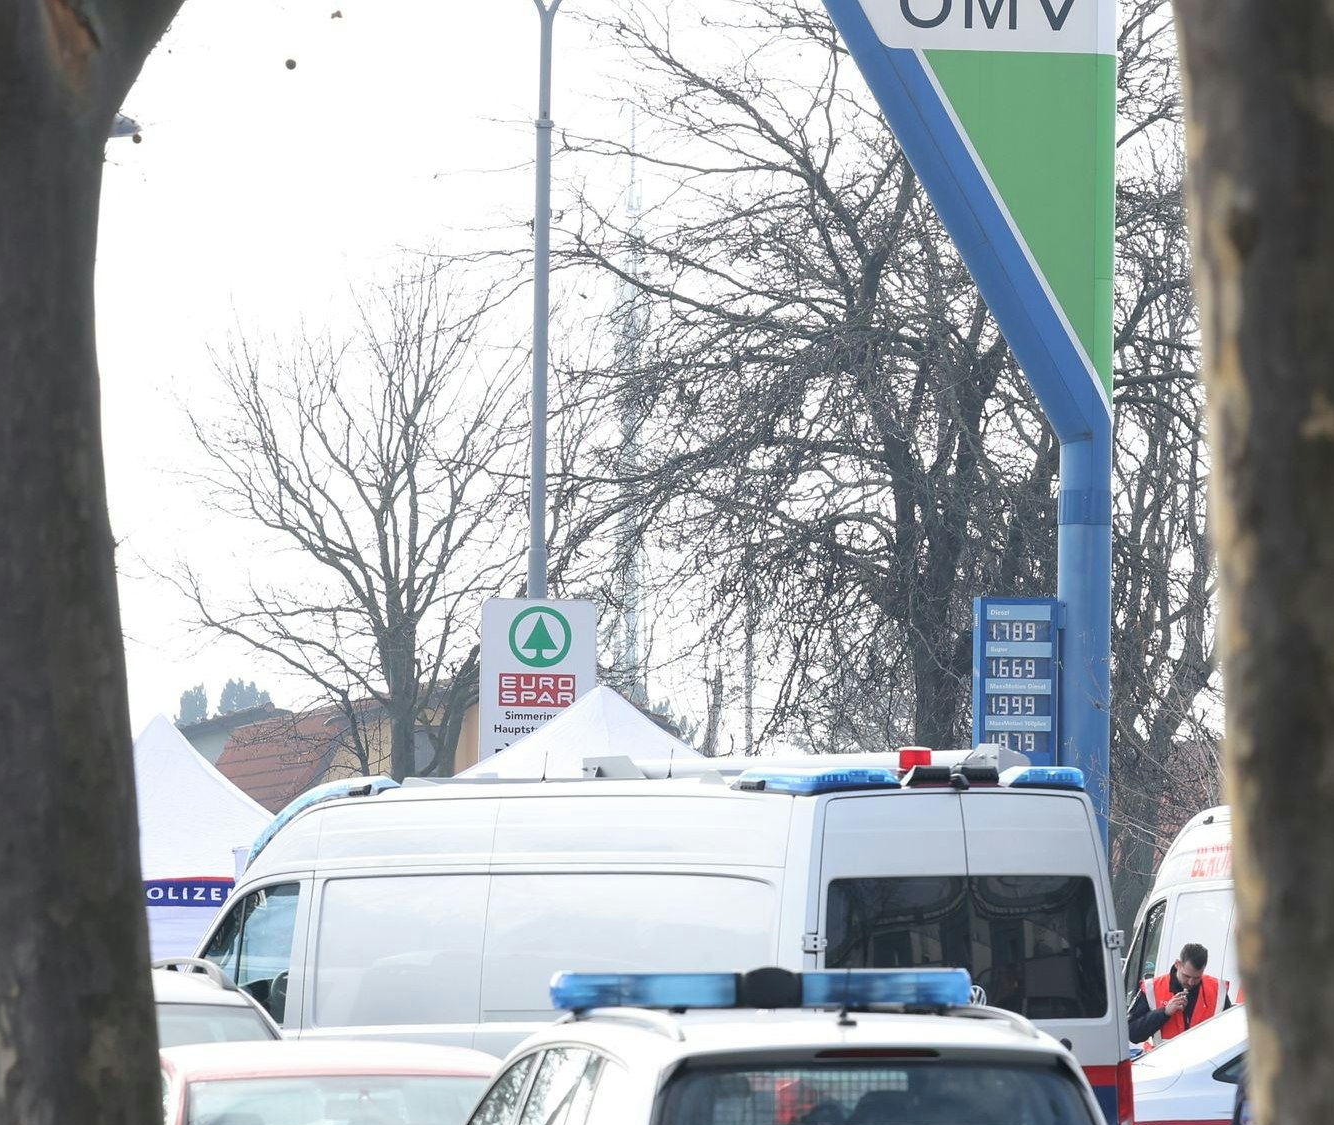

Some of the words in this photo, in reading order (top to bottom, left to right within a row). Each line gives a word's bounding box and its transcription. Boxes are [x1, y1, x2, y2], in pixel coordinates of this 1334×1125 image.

[501, 676, 574, 690] EURO
[501, 690, 574, 705] SPAR
[494, 724, 539, 736] Hauptst
[146, 887, 234, 901] OLIZEI
